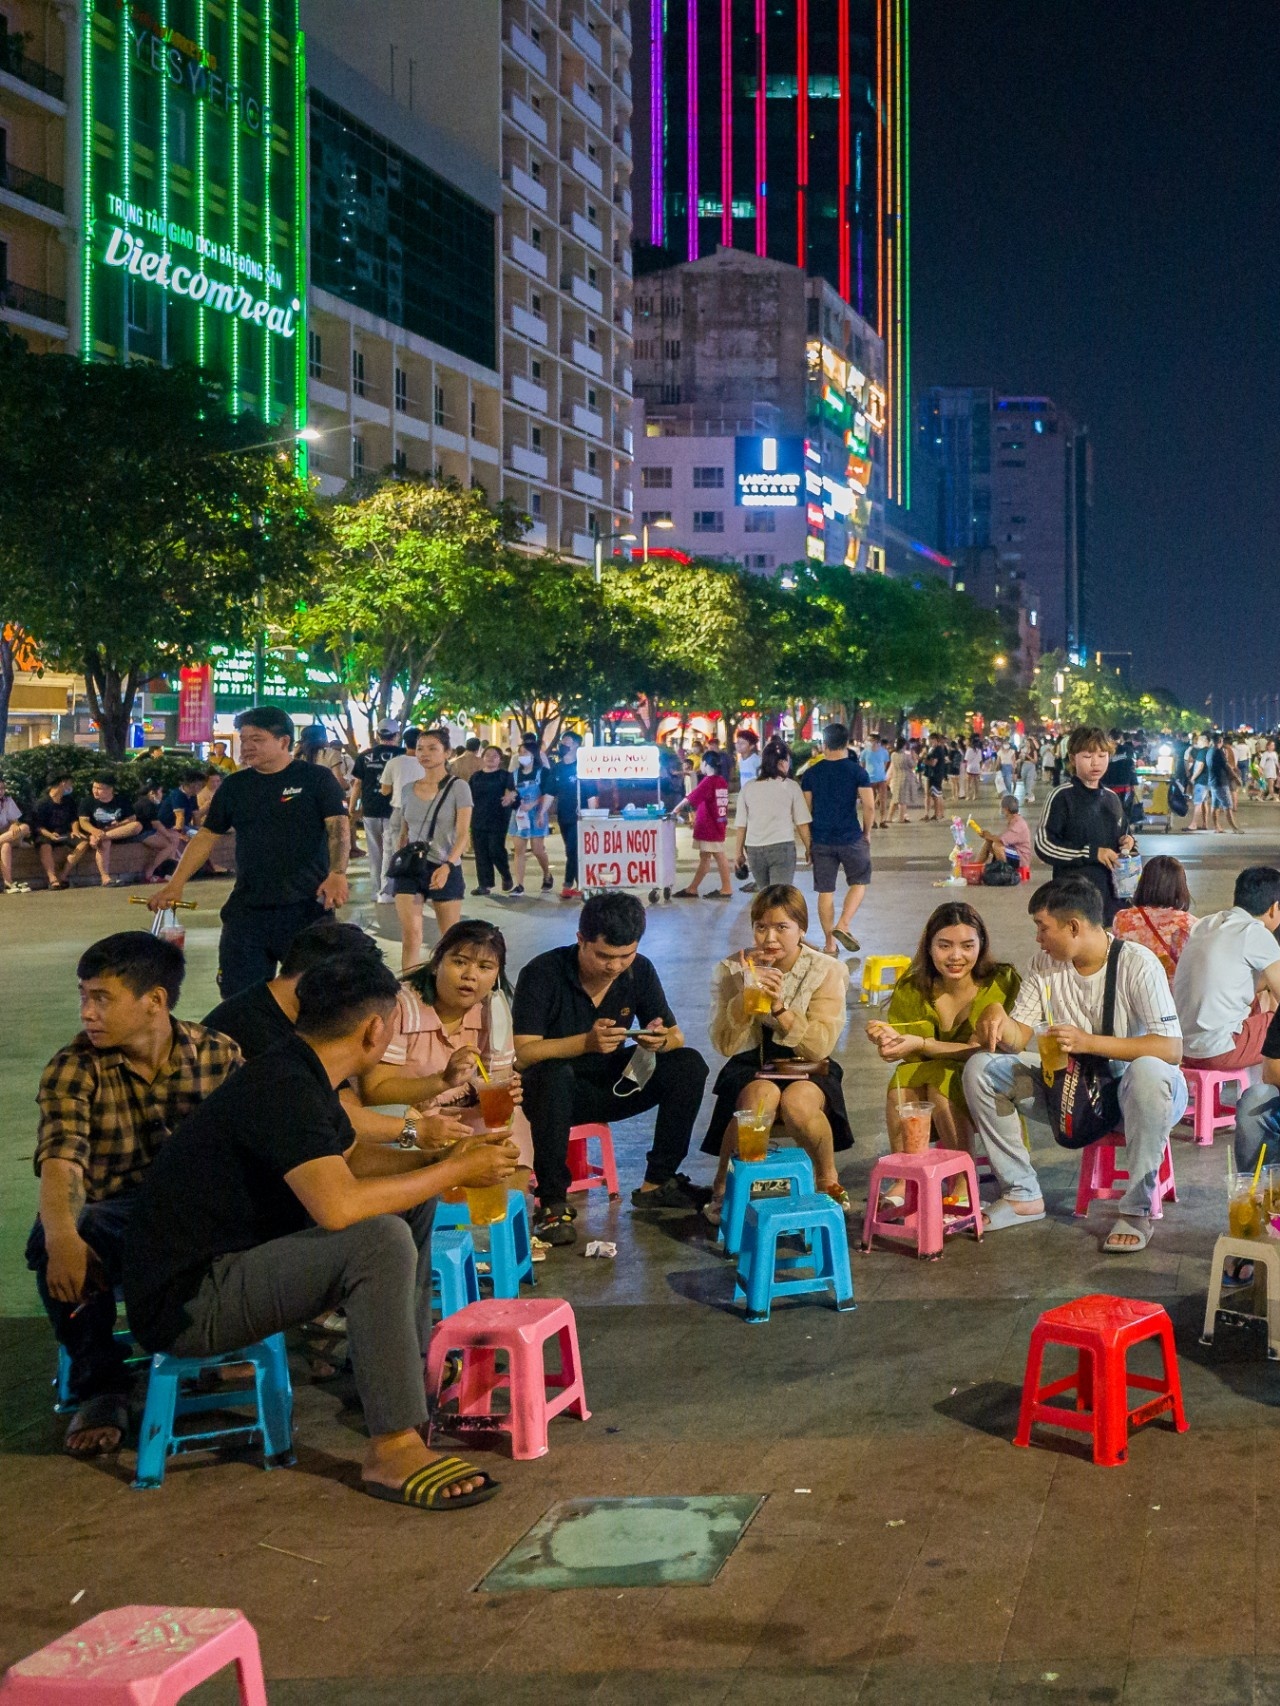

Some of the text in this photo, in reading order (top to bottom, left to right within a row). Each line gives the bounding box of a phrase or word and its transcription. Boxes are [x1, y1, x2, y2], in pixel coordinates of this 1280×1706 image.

[168, 222, 193, 249] GIAO
[584, 824, 657, 857] BÒ BÍA NGỌT
[1060, 1061, 1081, 1134] SCUDERIA FERRARI
